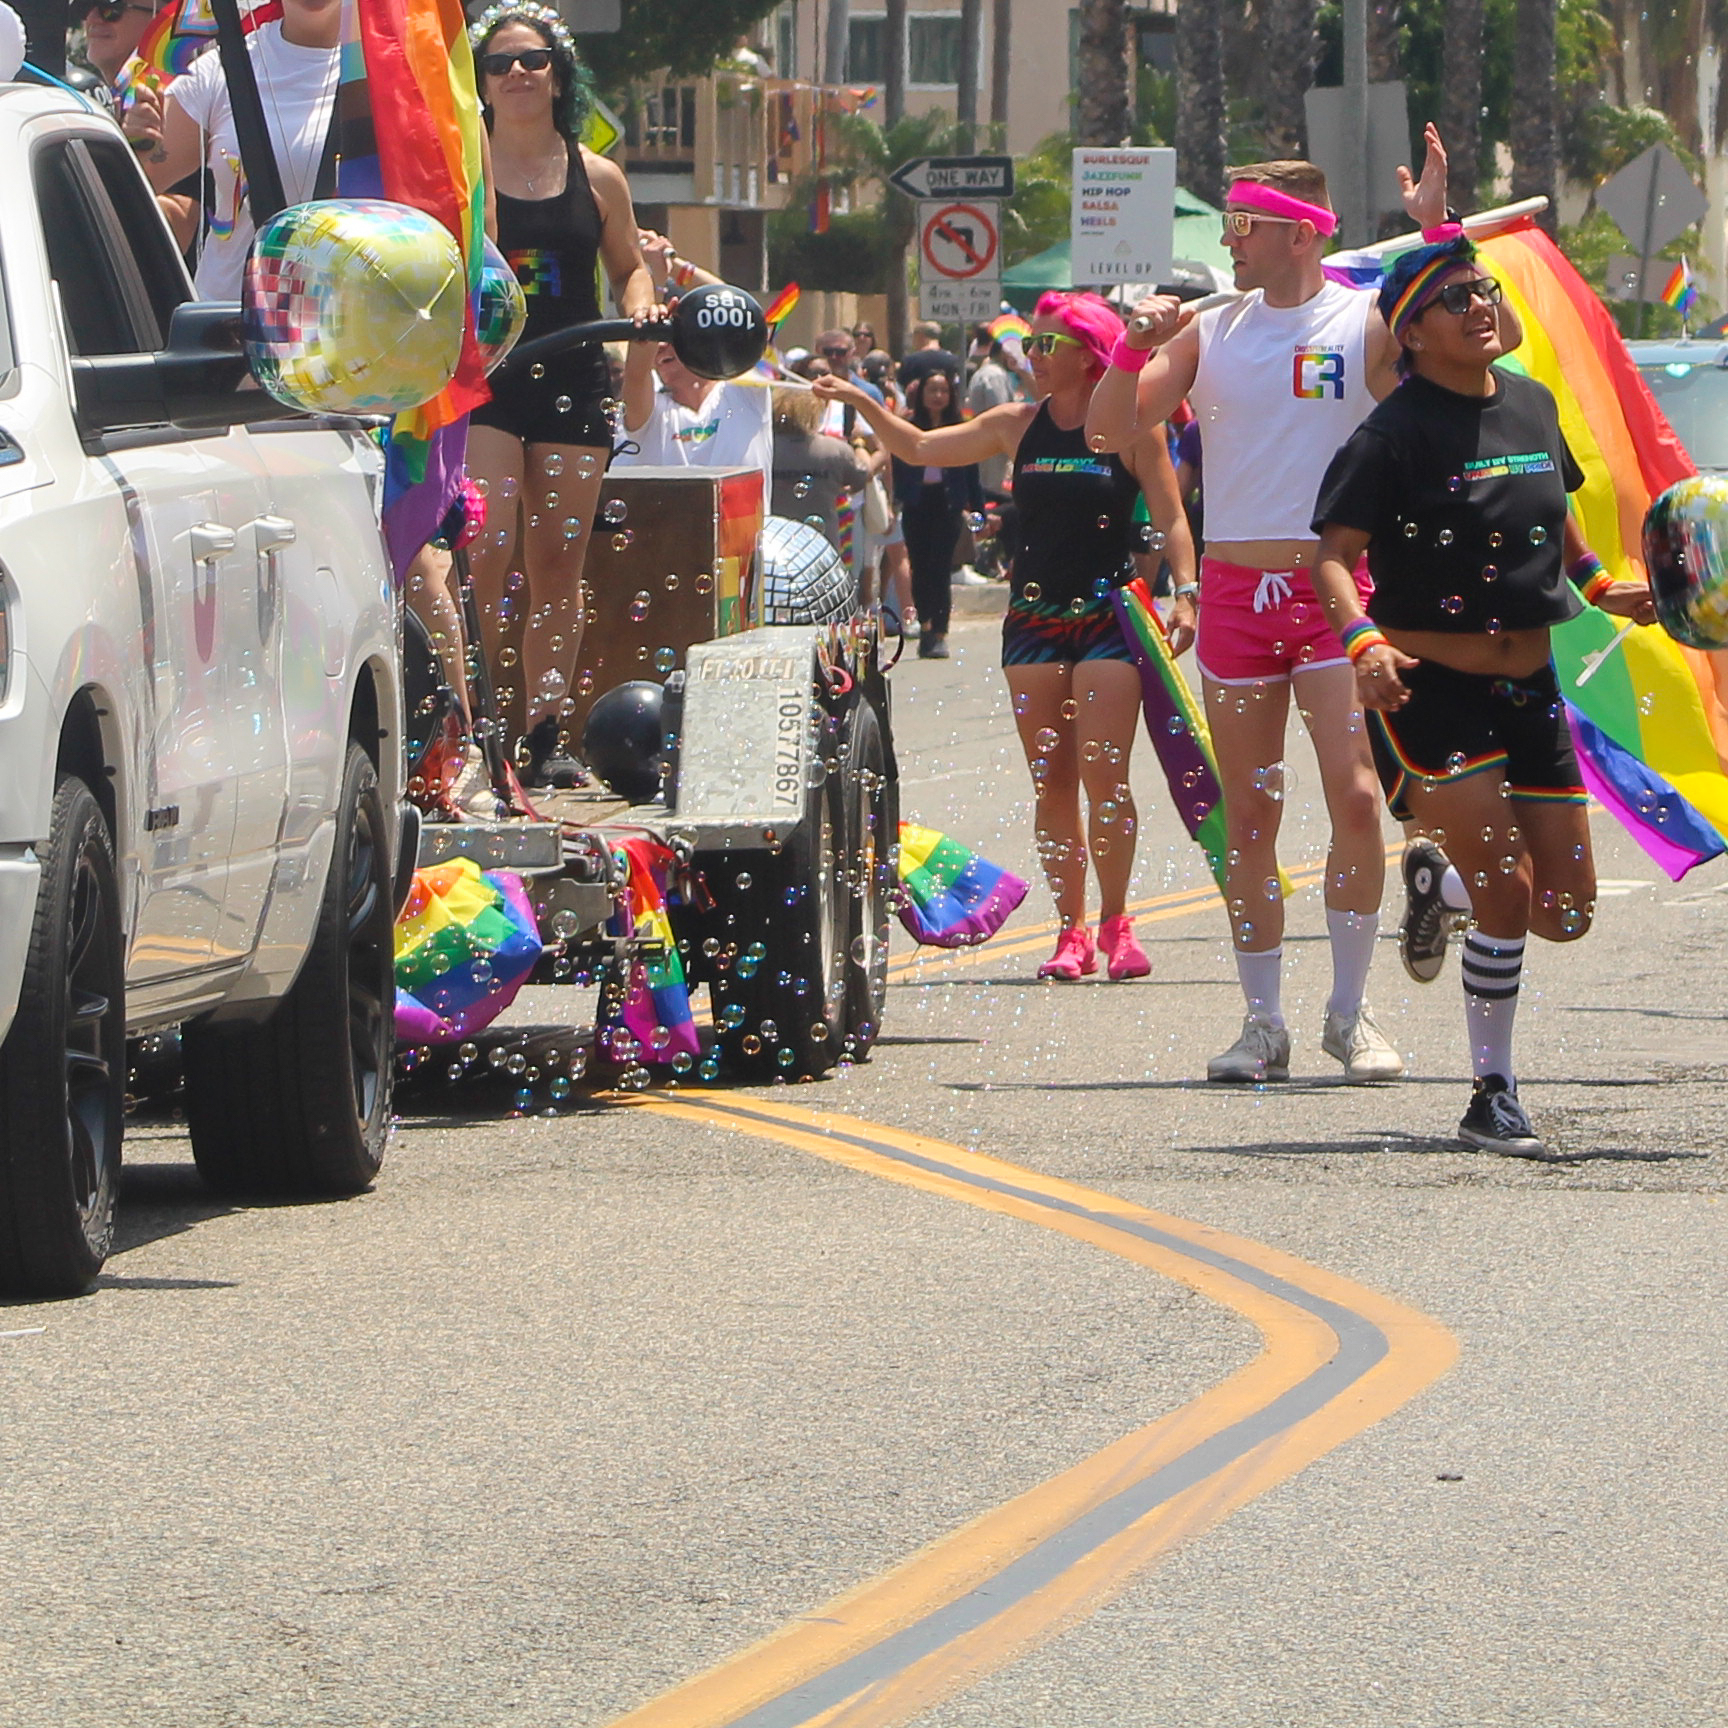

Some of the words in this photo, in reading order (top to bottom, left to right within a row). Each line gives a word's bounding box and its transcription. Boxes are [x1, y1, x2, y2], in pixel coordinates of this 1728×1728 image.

[1083, 154, 1150, 165] BURLESQUE
[926, 170, 960, 186] ONE
[965, 168, 1000, 185] WAY
[1082, 187, 1103, 197] HIP
[1105, 187, 1131, 197] HOP
[1082, 200, 1120, 211] SALSA
[1090, 262, 1128, 275] LEVEL
[1135, 262, 1152, 275] UP
[705, 290, 747, 310] LBS
[696, 306, 756, 331] 1000
